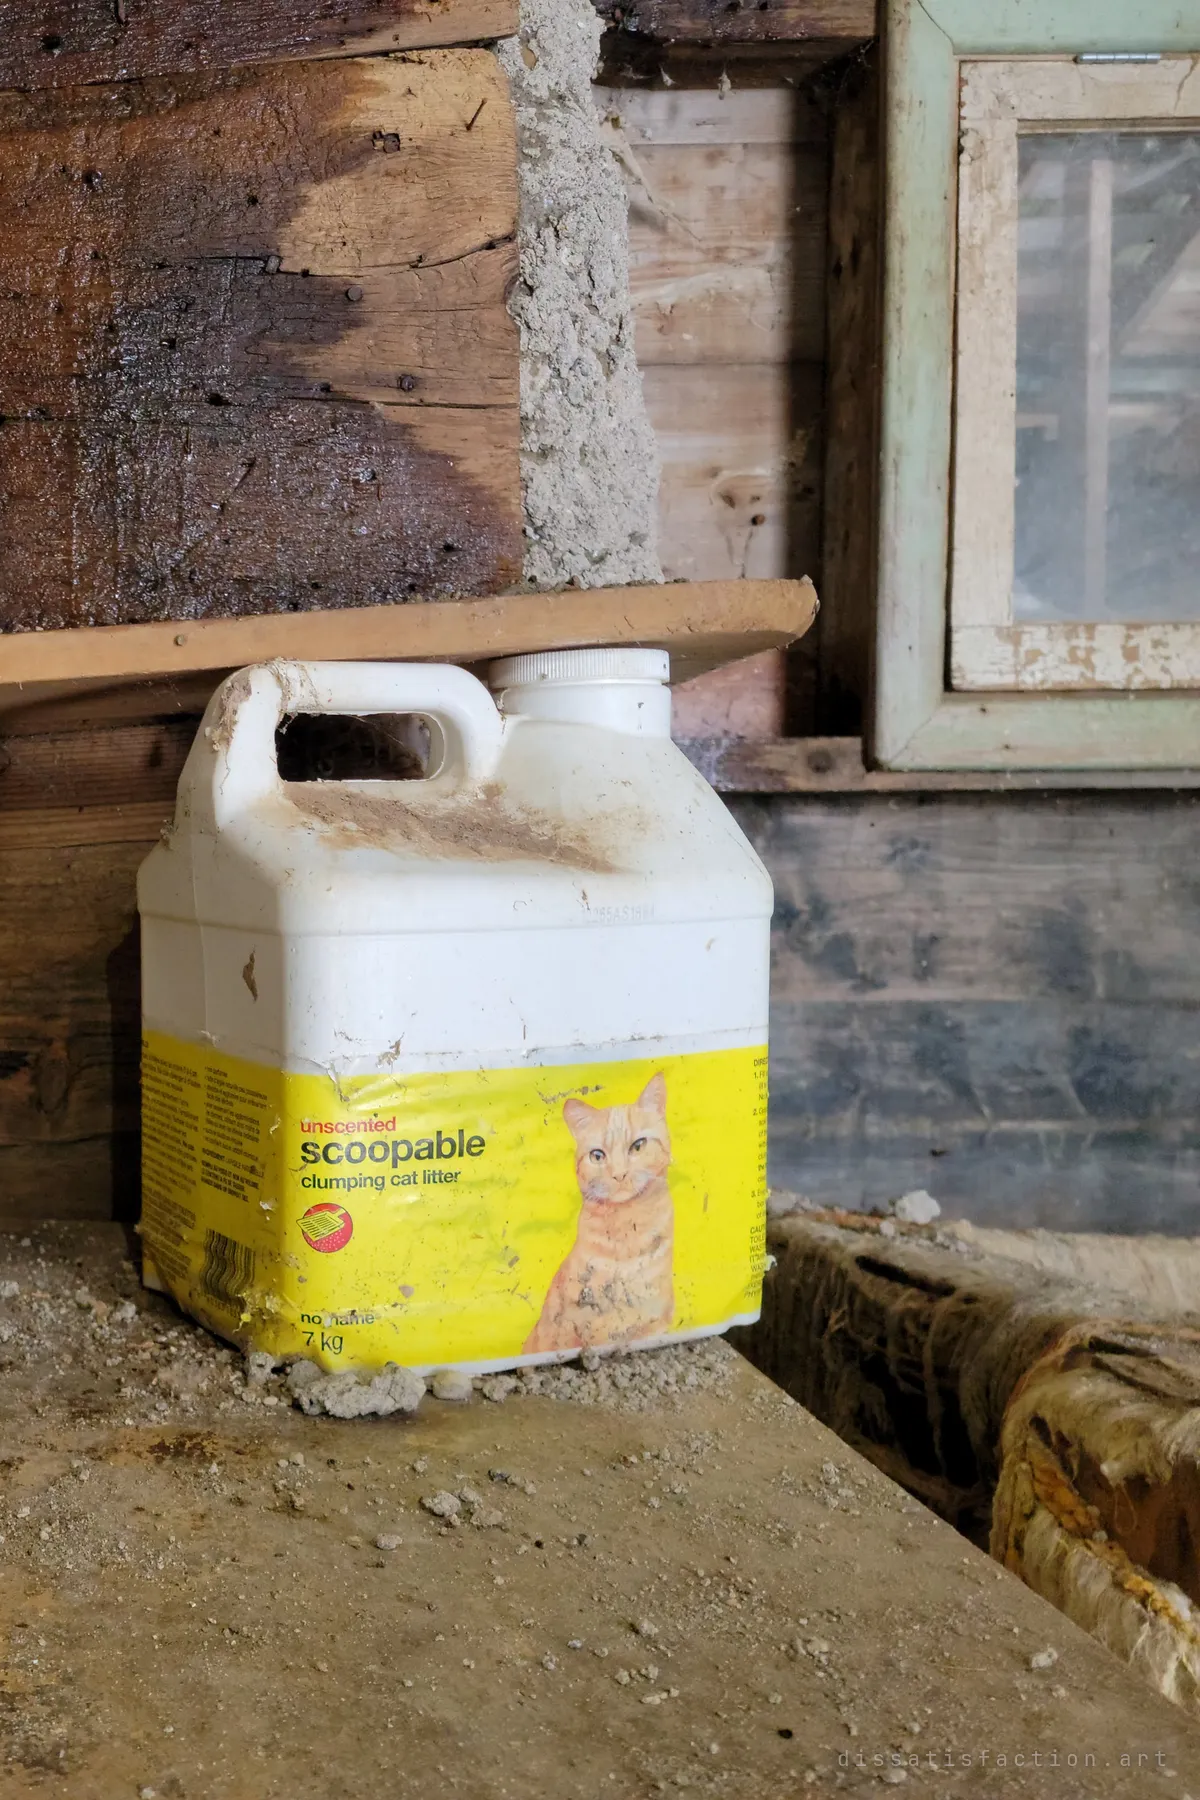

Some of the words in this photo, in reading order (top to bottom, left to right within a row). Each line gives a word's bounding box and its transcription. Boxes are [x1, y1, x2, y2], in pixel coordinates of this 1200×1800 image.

[300, 1116, 397, 1134] unscented
[300, 1129, 486, 1168] scoopable
[300, 1172, 385, 1192] clumping
[390, 1170, 418, 1187] cat
[422, 1168, 461, 1185] litter
[300, 1313, 322, 1325] no
[302, 1330, 314, 1347] 7
[321, 1331, 343, 1355] kg
